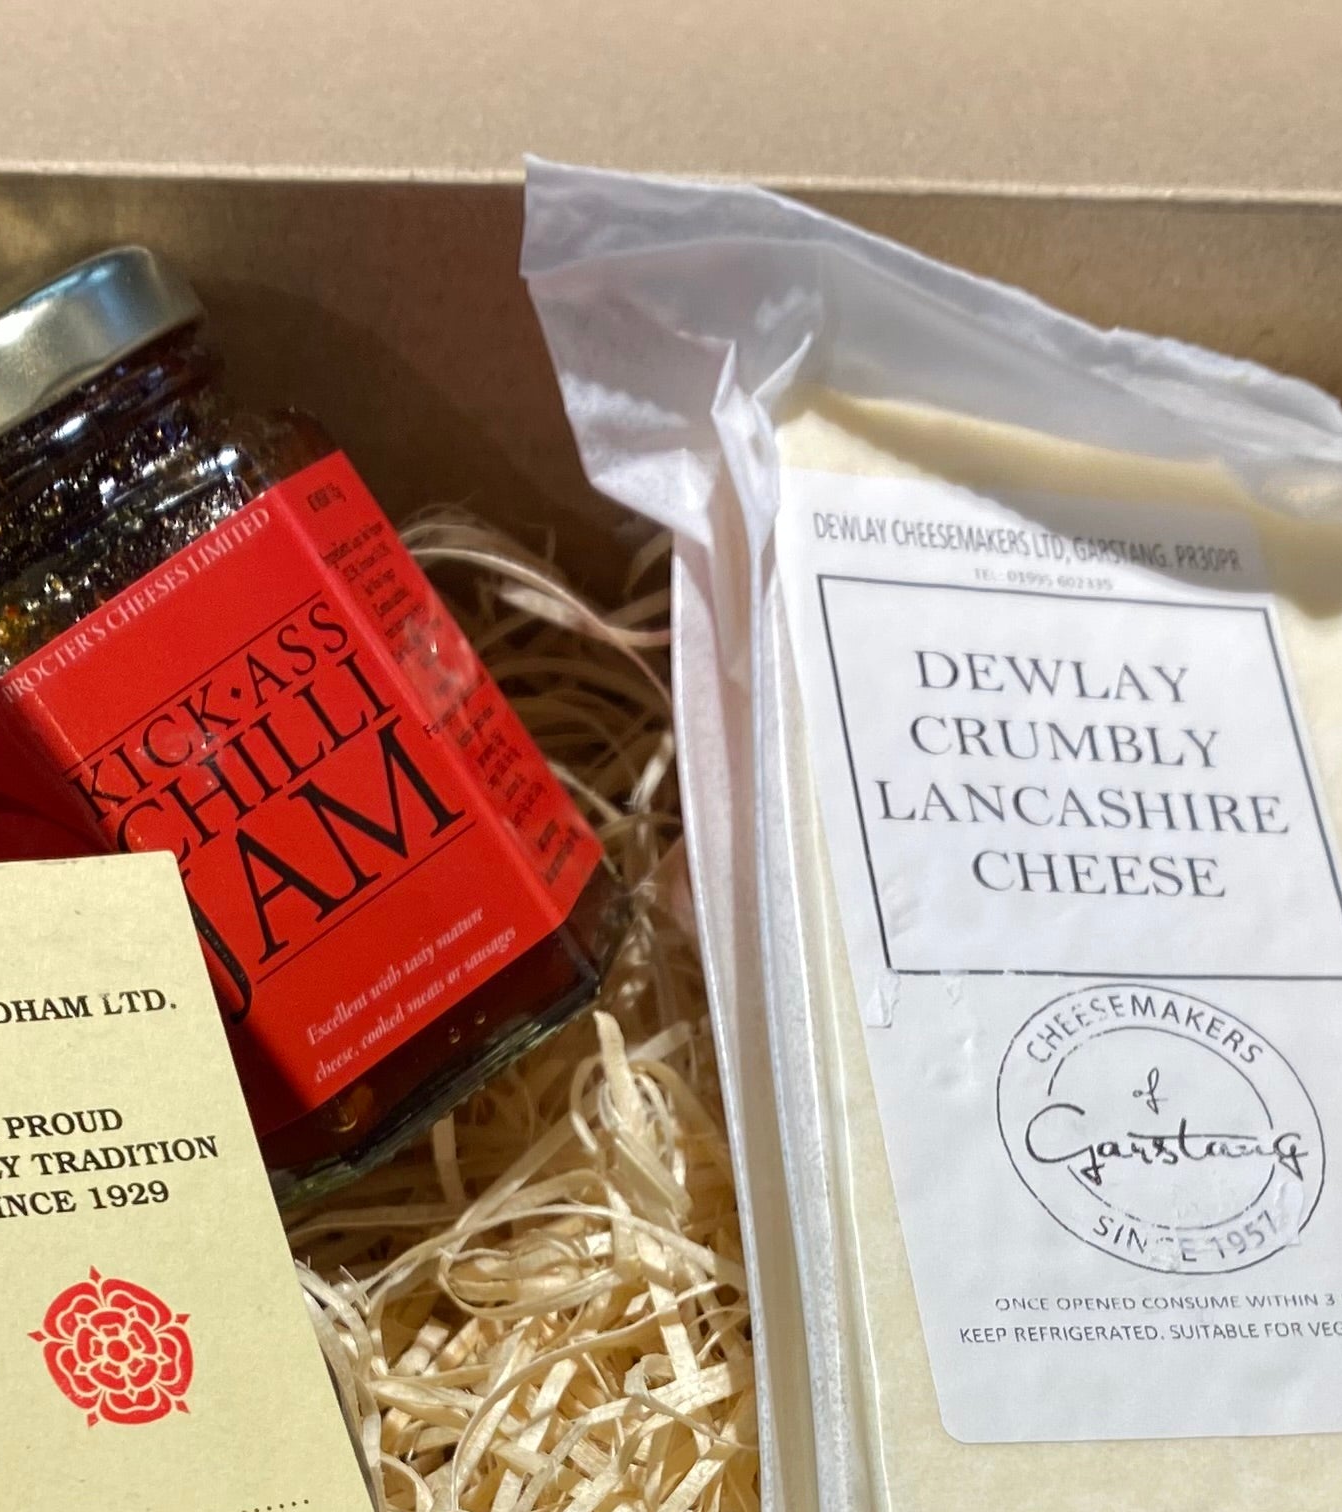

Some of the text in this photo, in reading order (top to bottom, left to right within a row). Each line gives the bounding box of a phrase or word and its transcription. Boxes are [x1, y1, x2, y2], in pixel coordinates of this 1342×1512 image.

[813, 511, 886, 546] DEWLAY
[891, 518, 1030, 557] CHEESEMAKERS
[105, 565, 189, 630] CHEESES
[187, 508, 271, 574] LIMITED
[913, 649, 1190, 704] DEWLAY
[116, 652, 395, 866] CHILLI
[909, 714, 1219, 769] CRUMBLY
[874, 780, 1291, 835] LANCASHIRE
[181, 721, 466, 1024] JAM
[971, 849, 1226, 898] CHEESE
[100, 988, 177, 1017] LTD.
[306, 907, 484, 1046] Excellent with tasty mature
[361, 1003, 405, 1050] cooked
[406, 979, 446, 1020] meats
[446, 965, 463, 986] or
[463, 925, 516, 975] sausages
[1026, 993, 1263, 1066] CHEESEMAKERS
[1132, 1067, 1168, 1114] of
[3, 1108, 123, 1140] PROUD
[1025, 1102, 1309, 1187] Garstang
[31, 1135, 219, 1176] TRADITION
[87, 1179, 170, 1211] 1929
[1092, 1215, 1197, 1262] SINE
[995, 1296, 1050, 1312] ONCE
[1056, 1296, 1136, 1312] OPENED
[1142, 1295, 1240, 1311] CONSUME
[1245, 1293, 1319, 1309] WITHIN
[1325, 1293, 1336, 1307] 3
[959, 1327, 1007, 1345] KEEP
[1013, 1325, 1165, 1343] REFRIGERATED.
[1169, 1323, 1259, 1341] SUITABLE
[1264, 1322, 1303, 1339] FOR
